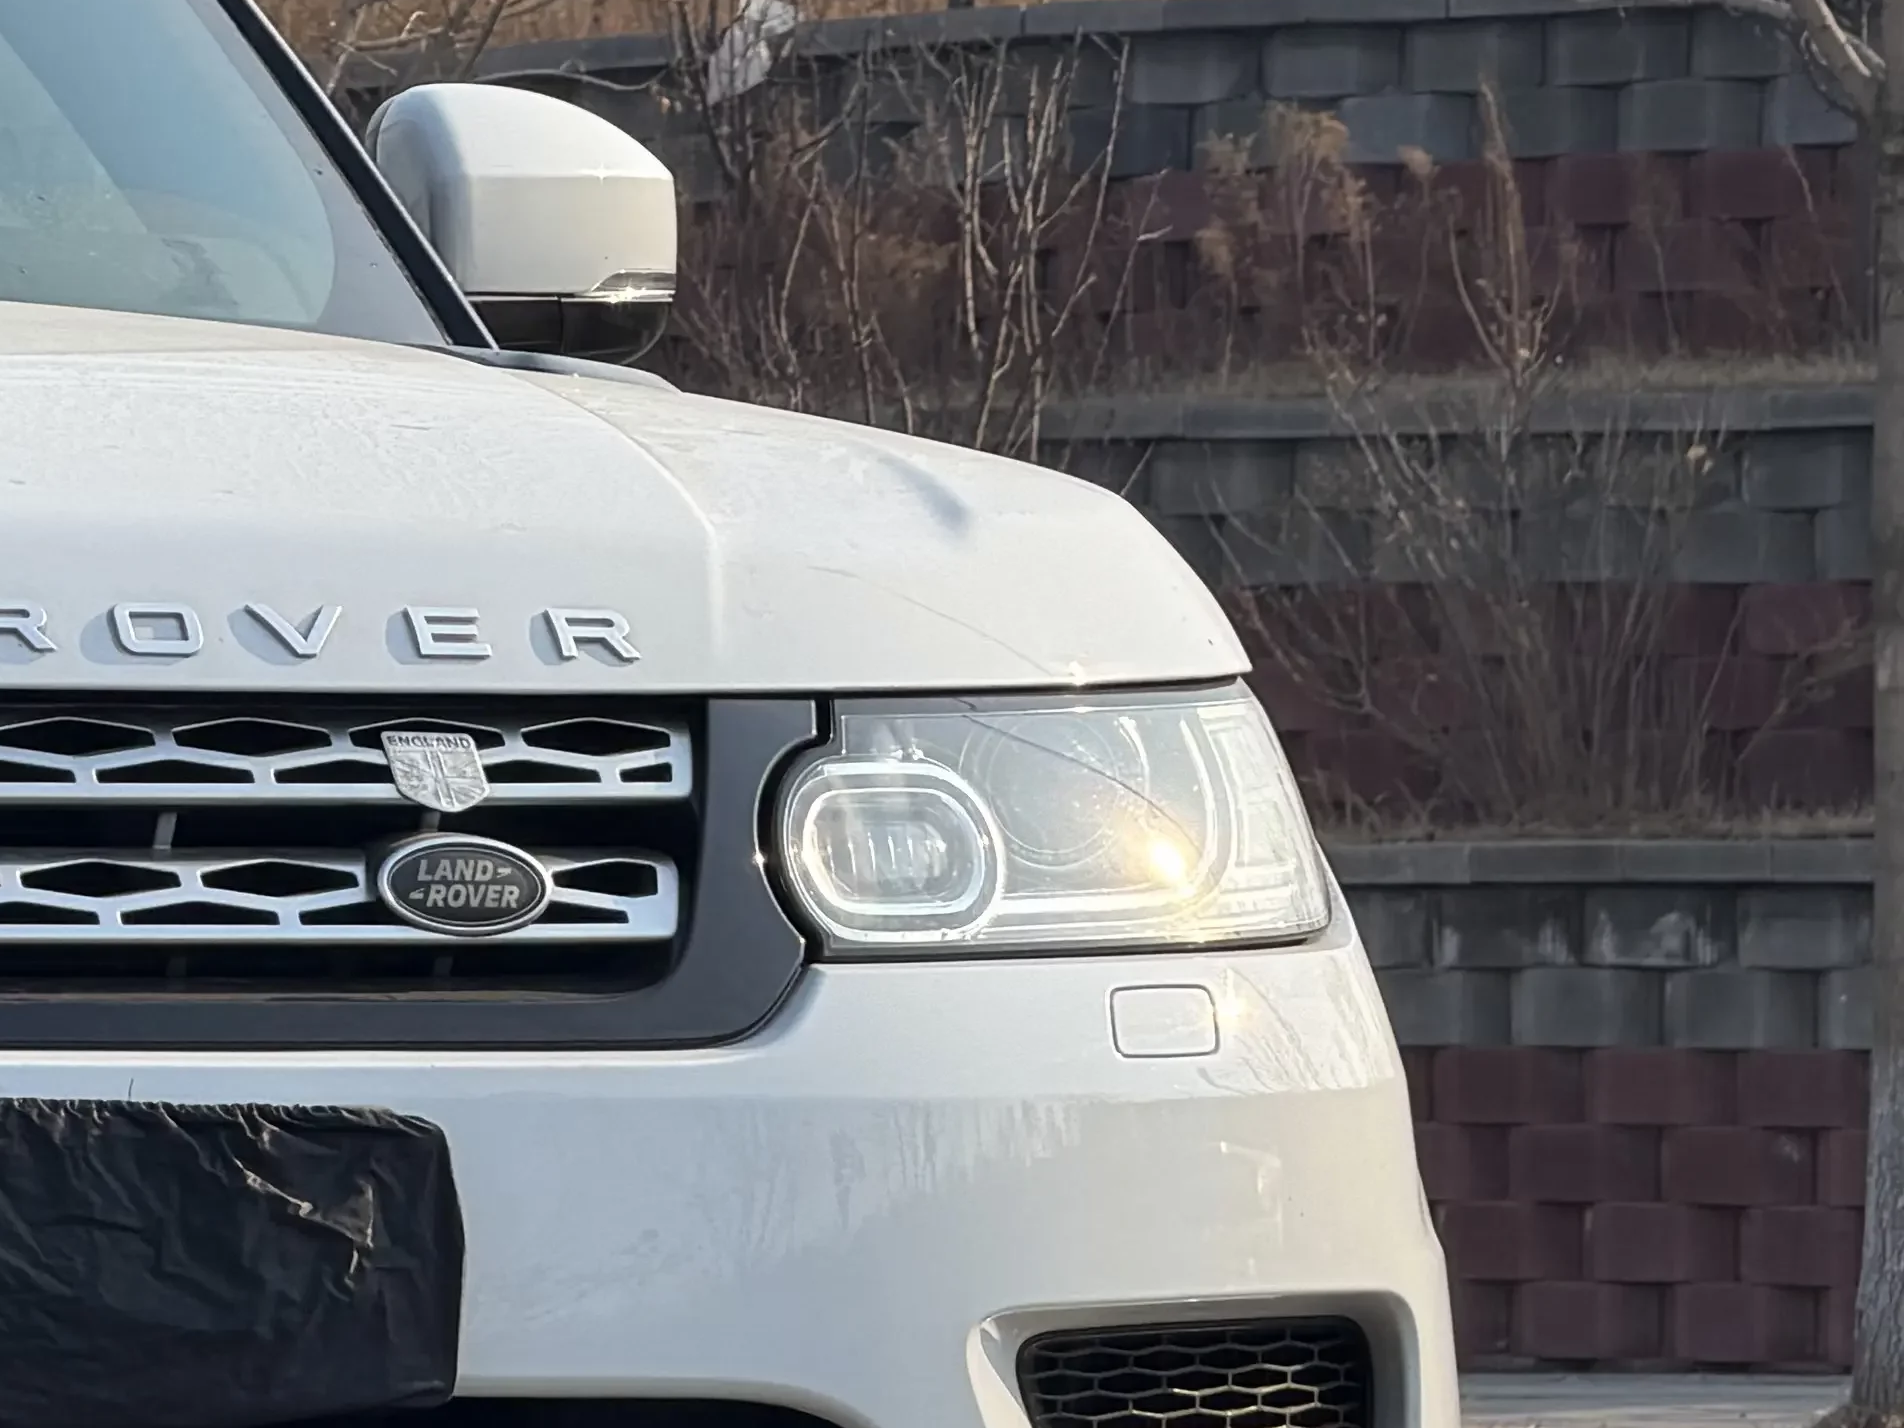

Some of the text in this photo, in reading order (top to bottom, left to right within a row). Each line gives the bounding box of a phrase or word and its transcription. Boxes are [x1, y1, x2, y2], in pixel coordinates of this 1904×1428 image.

[386, 735, 472, 750] ENGLAND
[417, 859, 493, 882] LAND
[426, 885, 520, 909] ROVER
